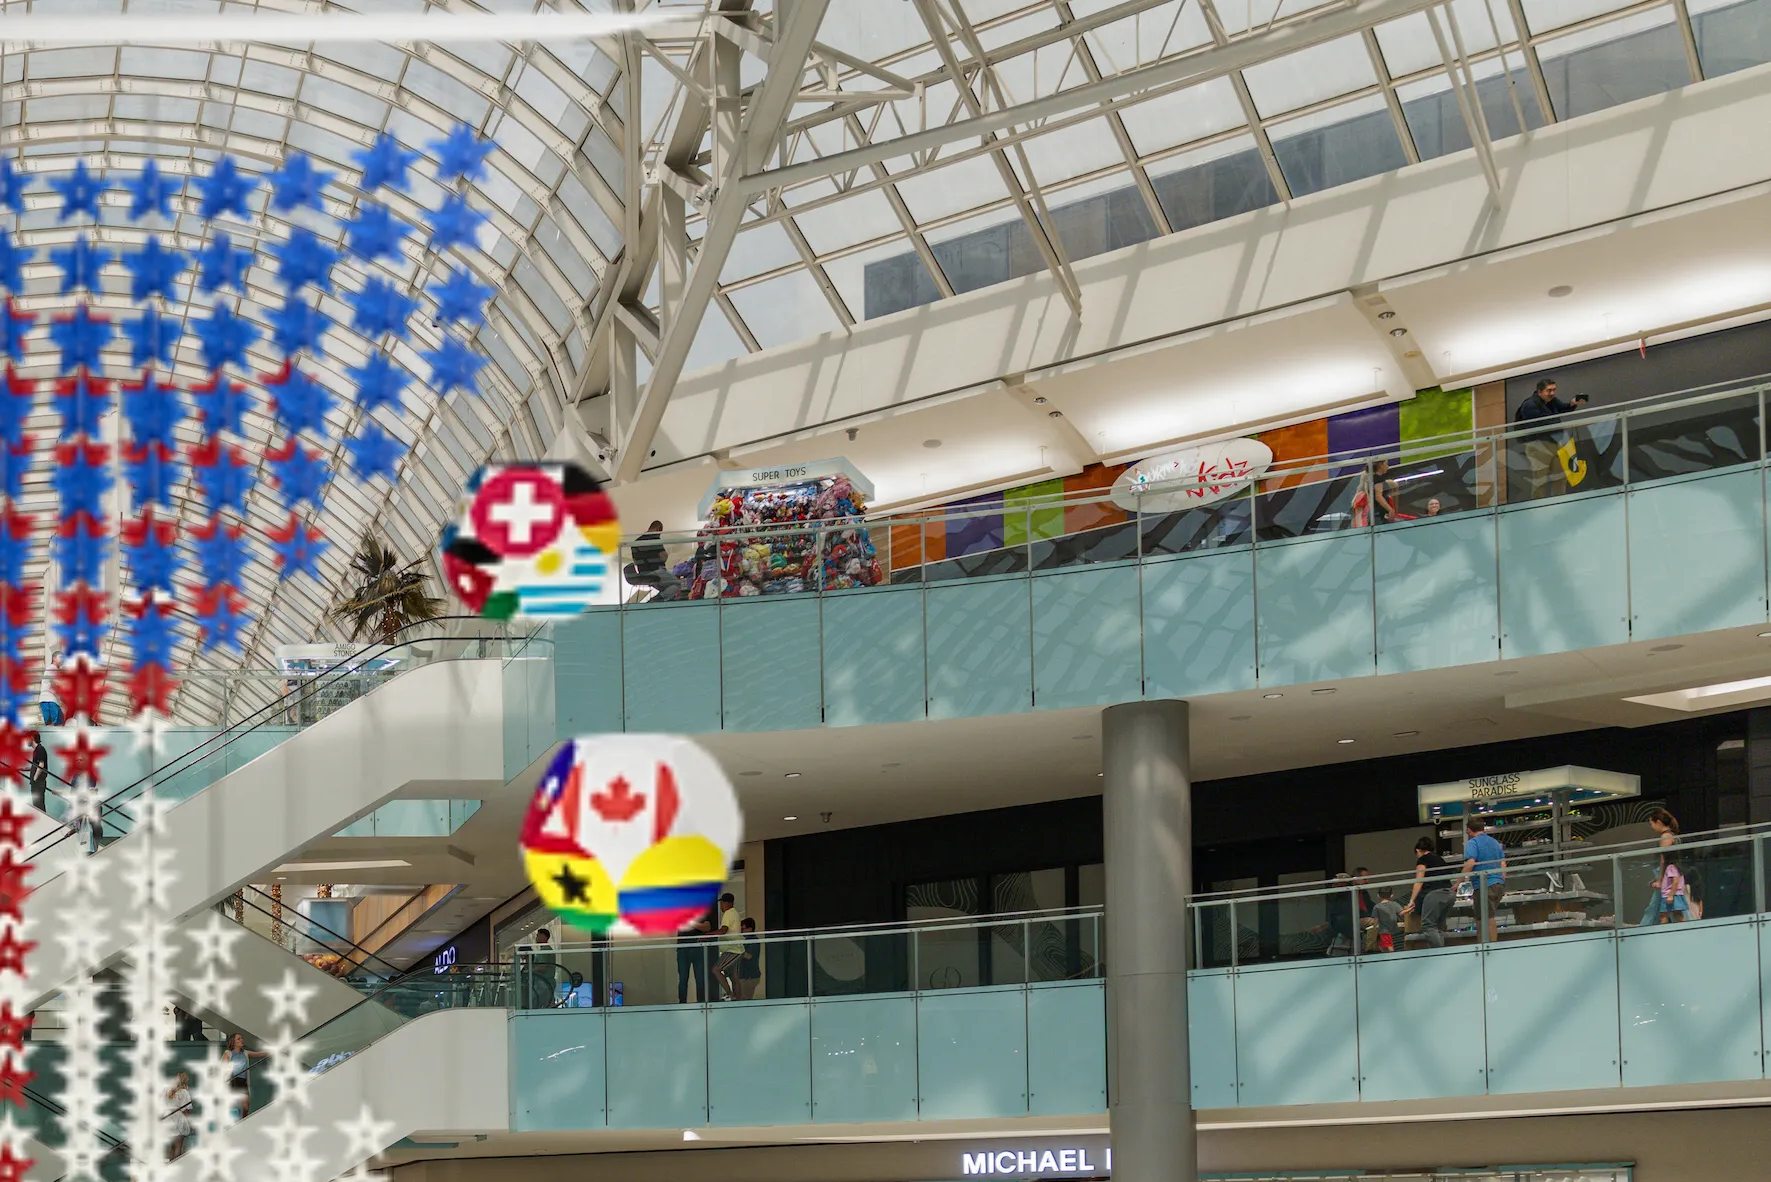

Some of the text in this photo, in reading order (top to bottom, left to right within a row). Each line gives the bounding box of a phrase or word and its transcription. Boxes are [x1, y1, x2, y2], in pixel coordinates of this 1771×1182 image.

[752, 467, 807, 481] SUPER TOYS
[1469, 772, 1520, 789] SUNGLASS
[1471, 783, 1518, 798] PARADISE
[963, 1149, 1095, 1174] MICHAEL
